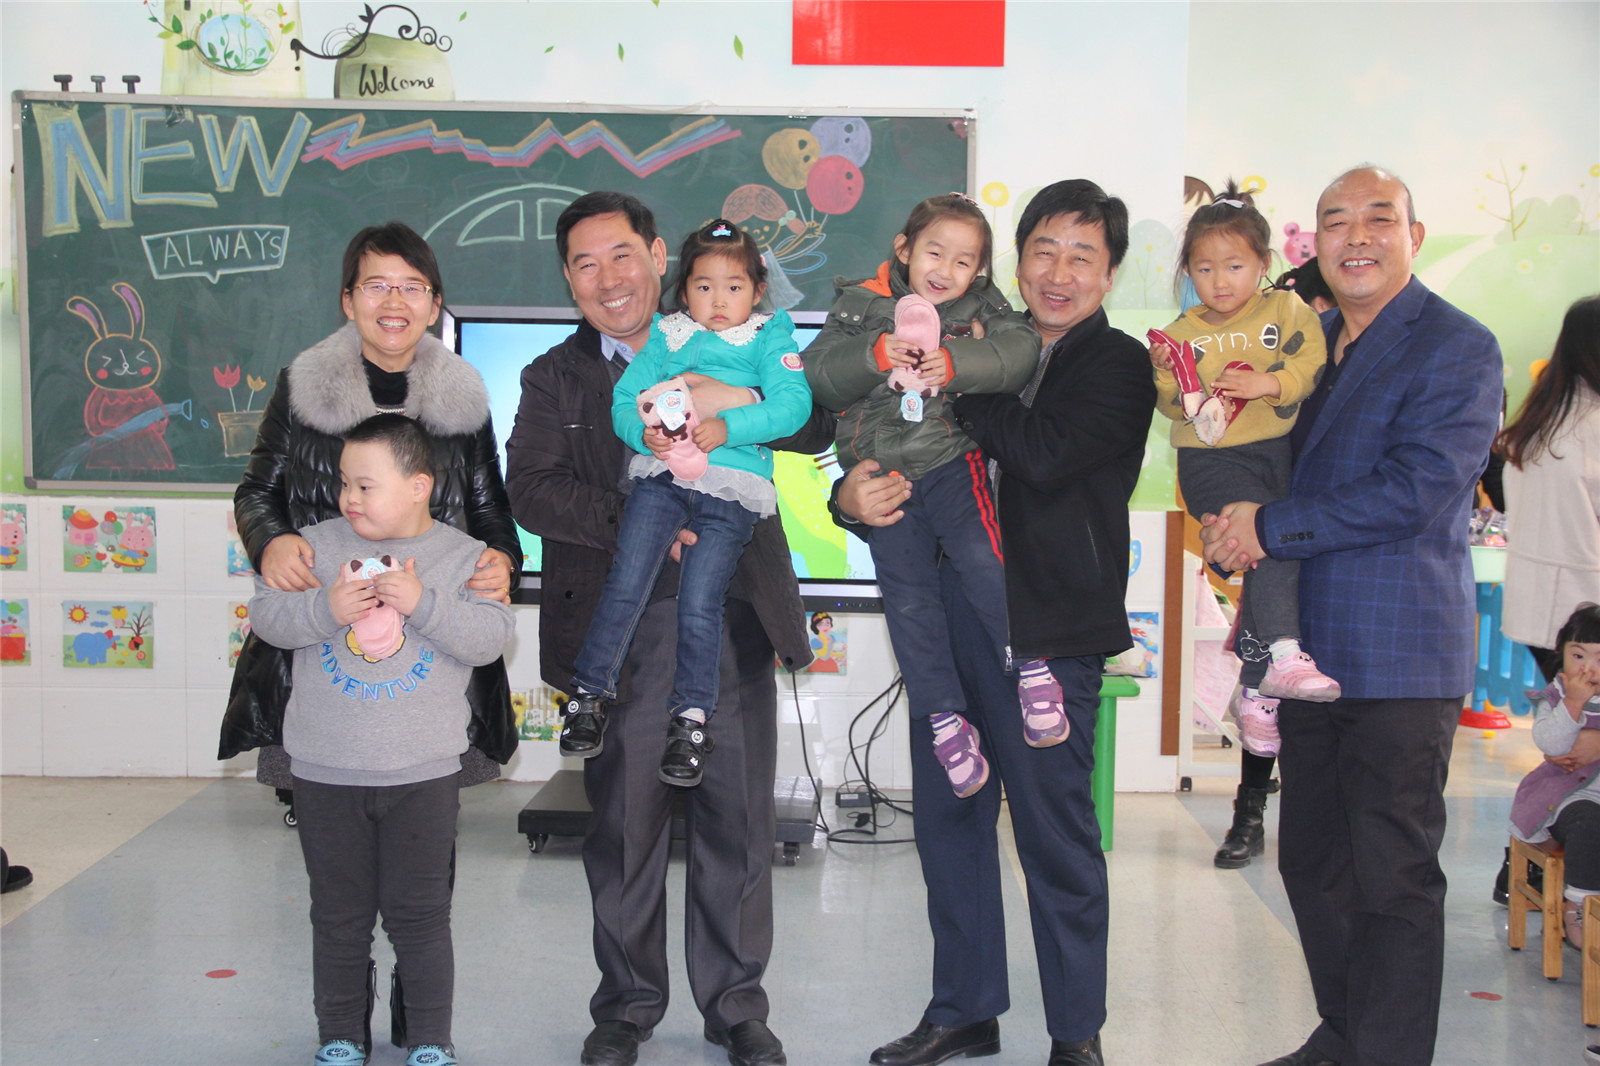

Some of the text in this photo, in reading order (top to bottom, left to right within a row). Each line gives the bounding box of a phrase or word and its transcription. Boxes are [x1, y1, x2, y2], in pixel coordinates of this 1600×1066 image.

[359, 64, 435, 97] Welcome
[32, 103, 312, 237] NEW
[163, 230, 282, 270] ALWAYS
[320, 642, 434, 701] ADVENTURE
